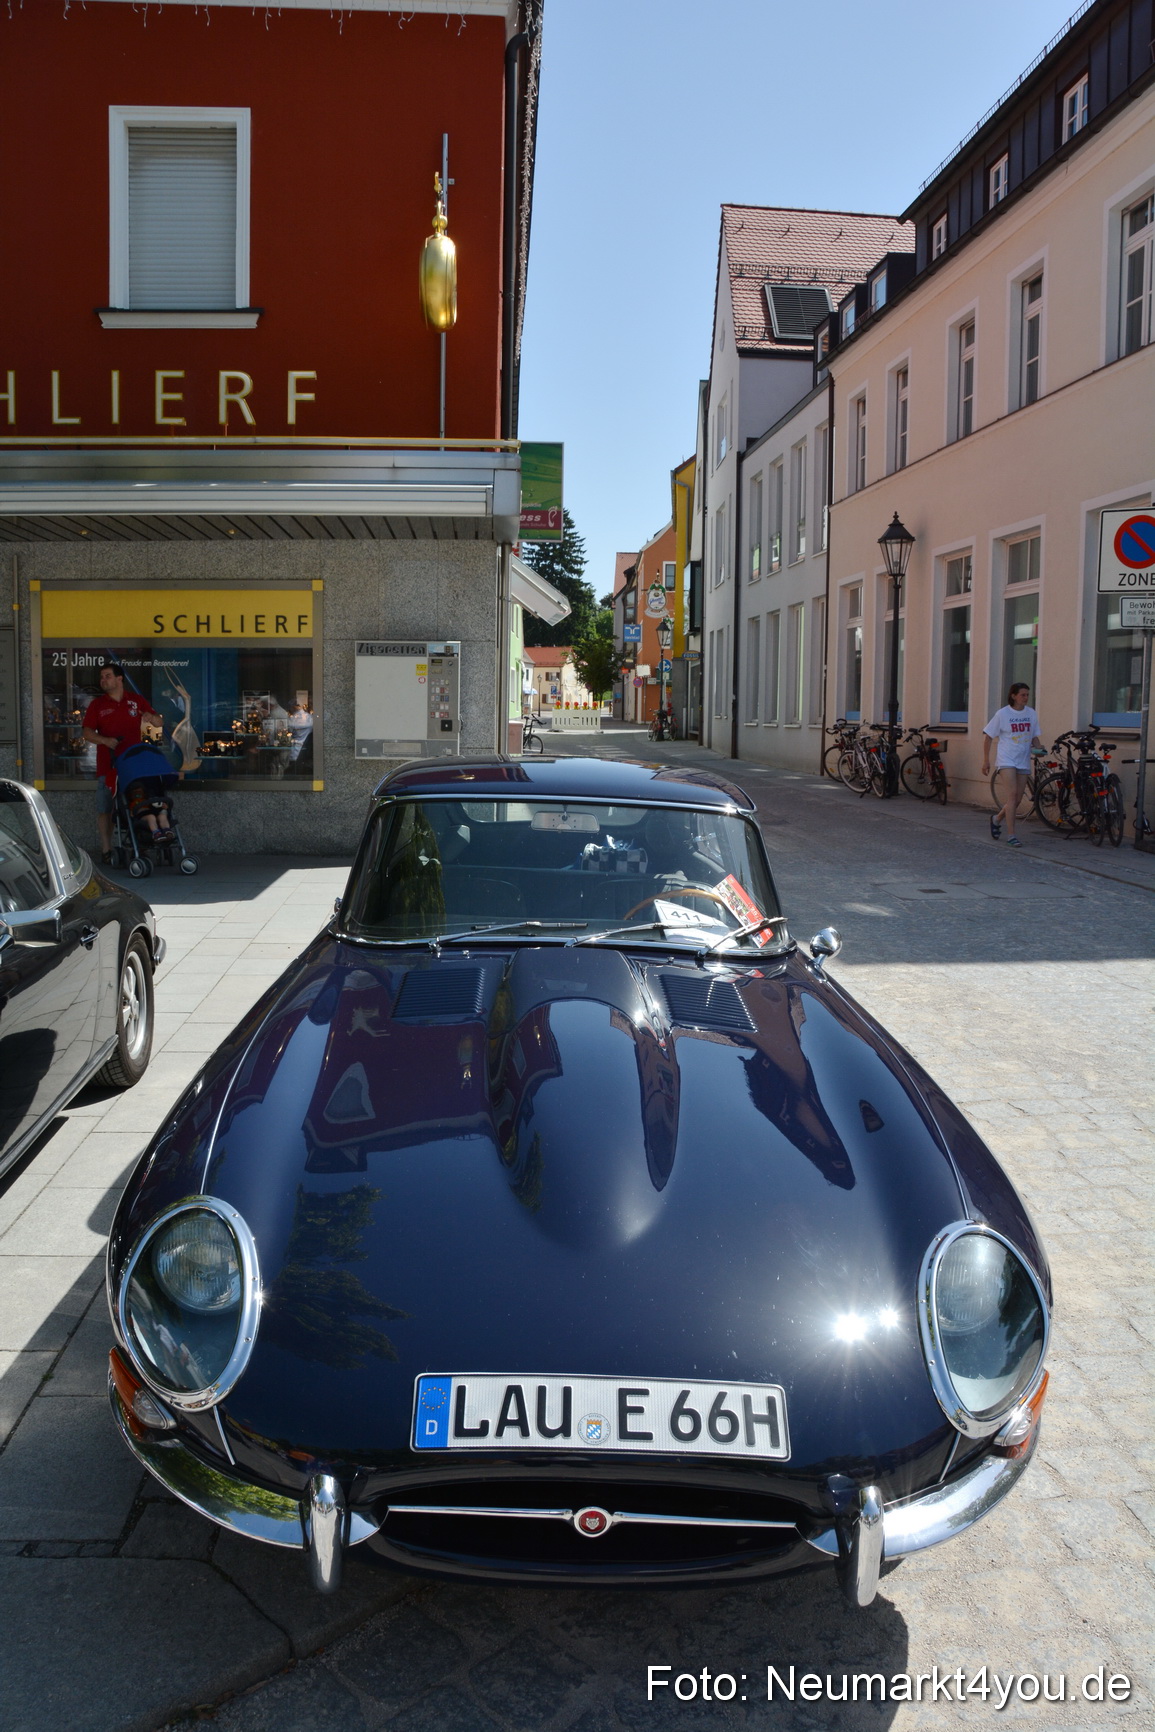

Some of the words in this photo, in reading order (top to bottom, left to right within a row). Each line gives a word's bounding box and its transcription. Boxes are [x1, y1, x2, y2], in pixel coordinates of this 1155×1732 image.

[153, 615, 309, 634] SCHLIERF
[52, 652, 67, 667] 25
[70, 652, 105, 667] Jahre
[121, 659, 142, 667] Freude
[153, 659, 189, 668] Besonderen!
[1010, 722, 1031, 733] ROT
[671, 911, 702, 922] 411
[425, 1419, 438, 1436] D
[454, 1383, 573, 1440] LAU
[617, 1387, 655, 1442] E
[669, 1389, 781, 1449] 66H
